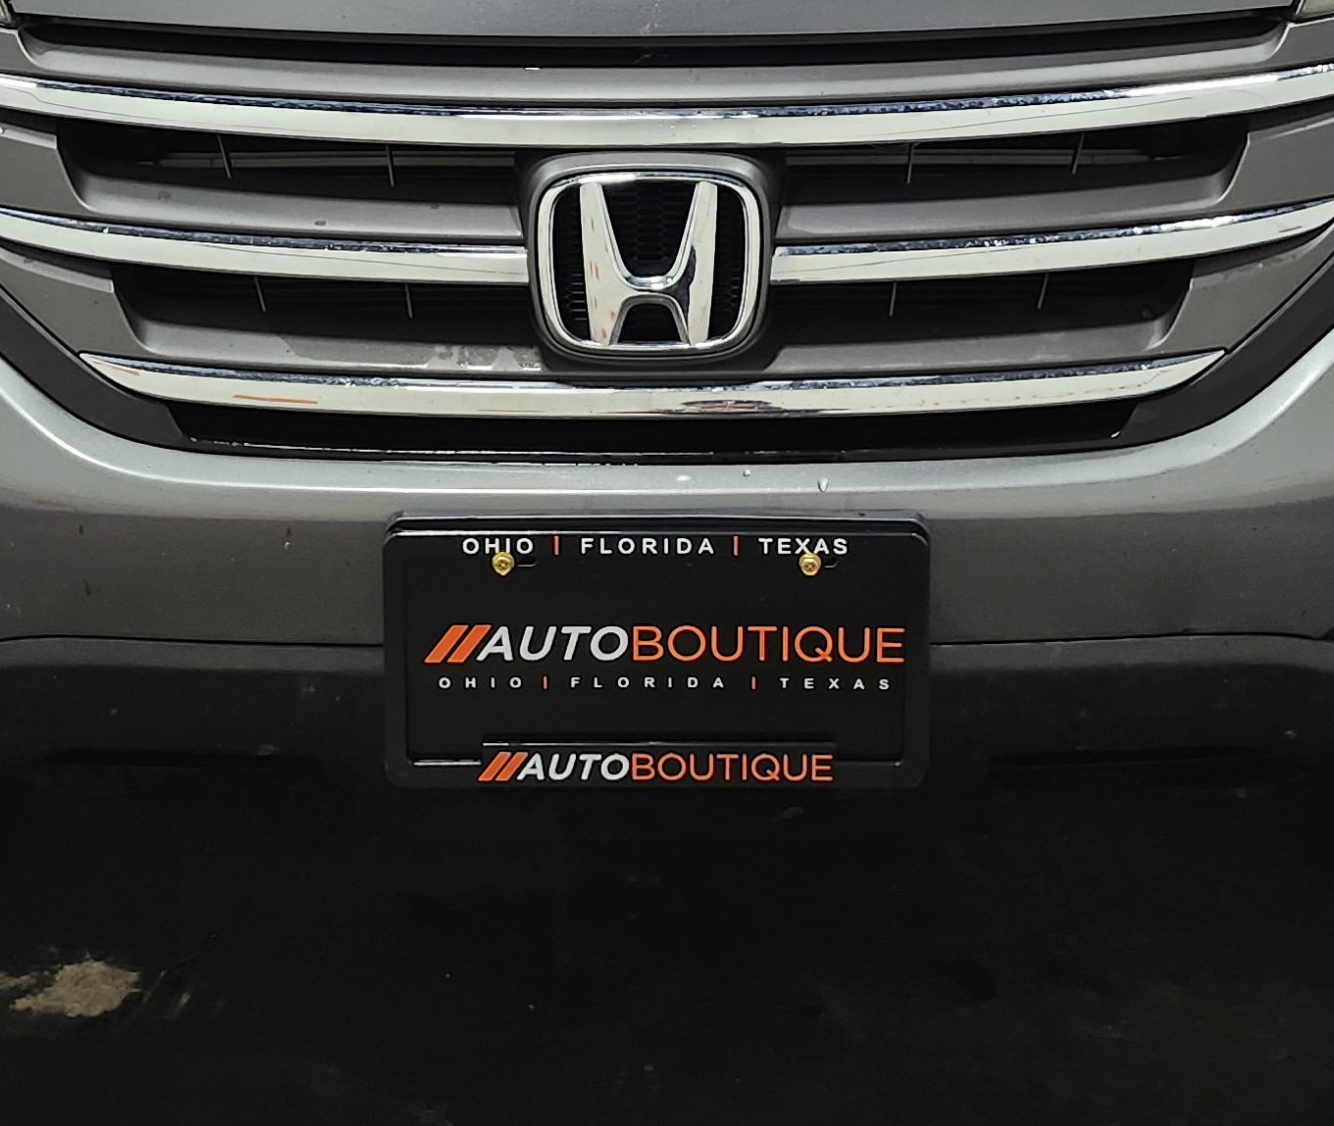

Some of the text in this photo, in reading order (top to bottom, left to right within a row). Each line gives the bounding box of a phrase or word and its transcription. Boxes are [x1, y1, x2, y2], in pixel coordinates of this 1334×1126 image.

[462, 537, 848, 555] OHIO FLORIDA TEXAS
[477, 625, 906, 664] AUTOBOUTIQUE
[439, 676, 891, 690] OHIO FLORIDA TEXAS
[517, 752, 834, 782] AUTOBOUTIQUE
